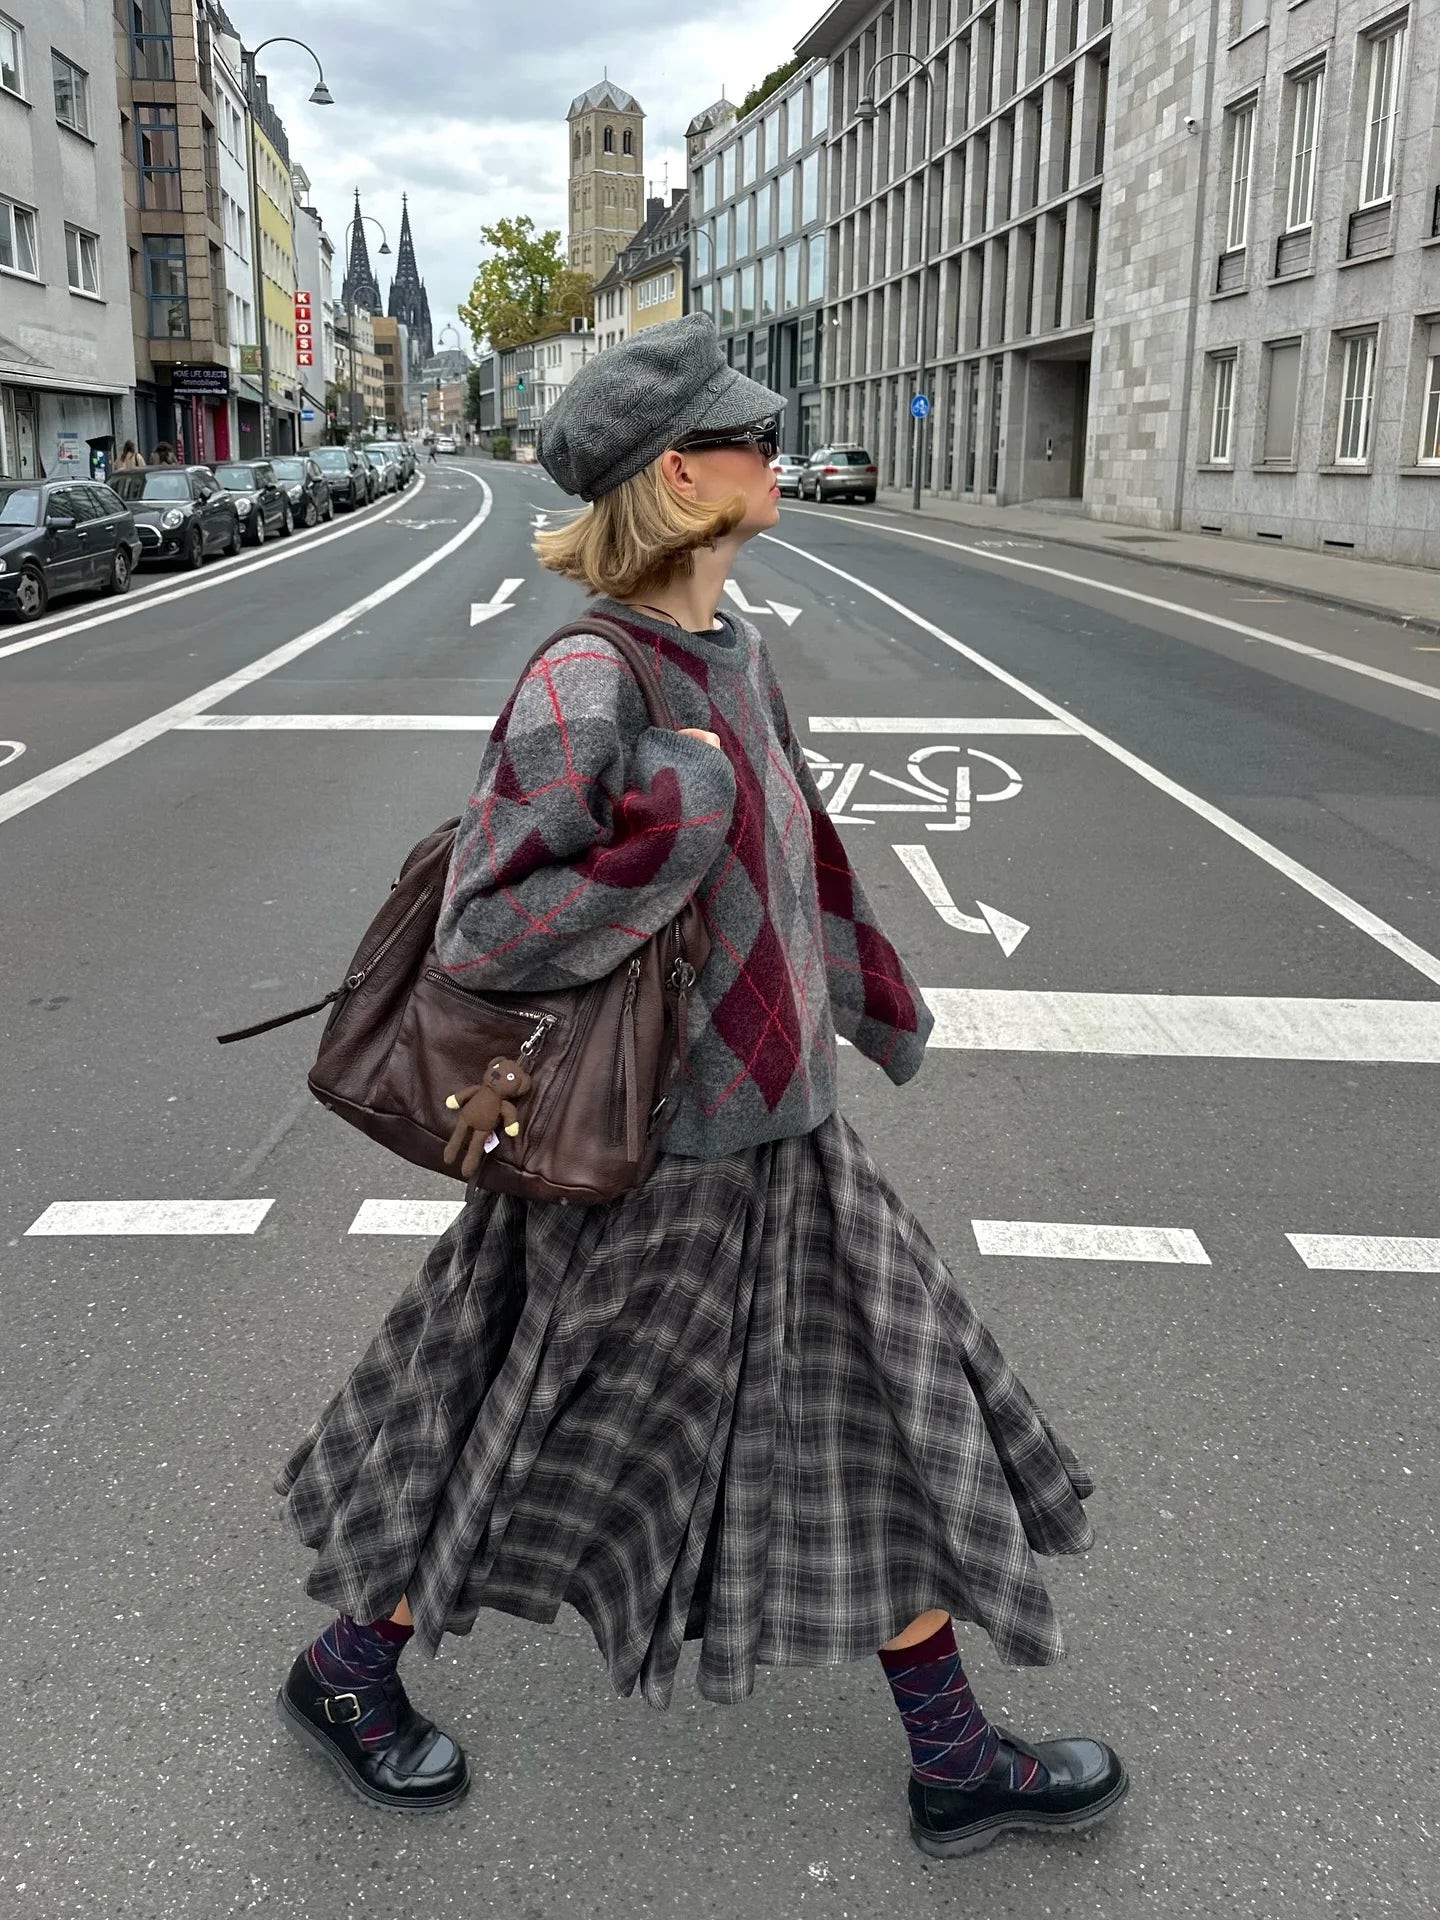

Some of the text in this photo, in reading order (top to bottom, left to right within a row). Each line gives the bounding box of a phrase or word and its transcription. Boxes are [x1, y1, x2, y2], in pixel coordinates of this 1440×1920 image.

[296, 293, 311, 365] KIOSK
[173, 370, 227, 379] HOME LIFE OBJECTS
